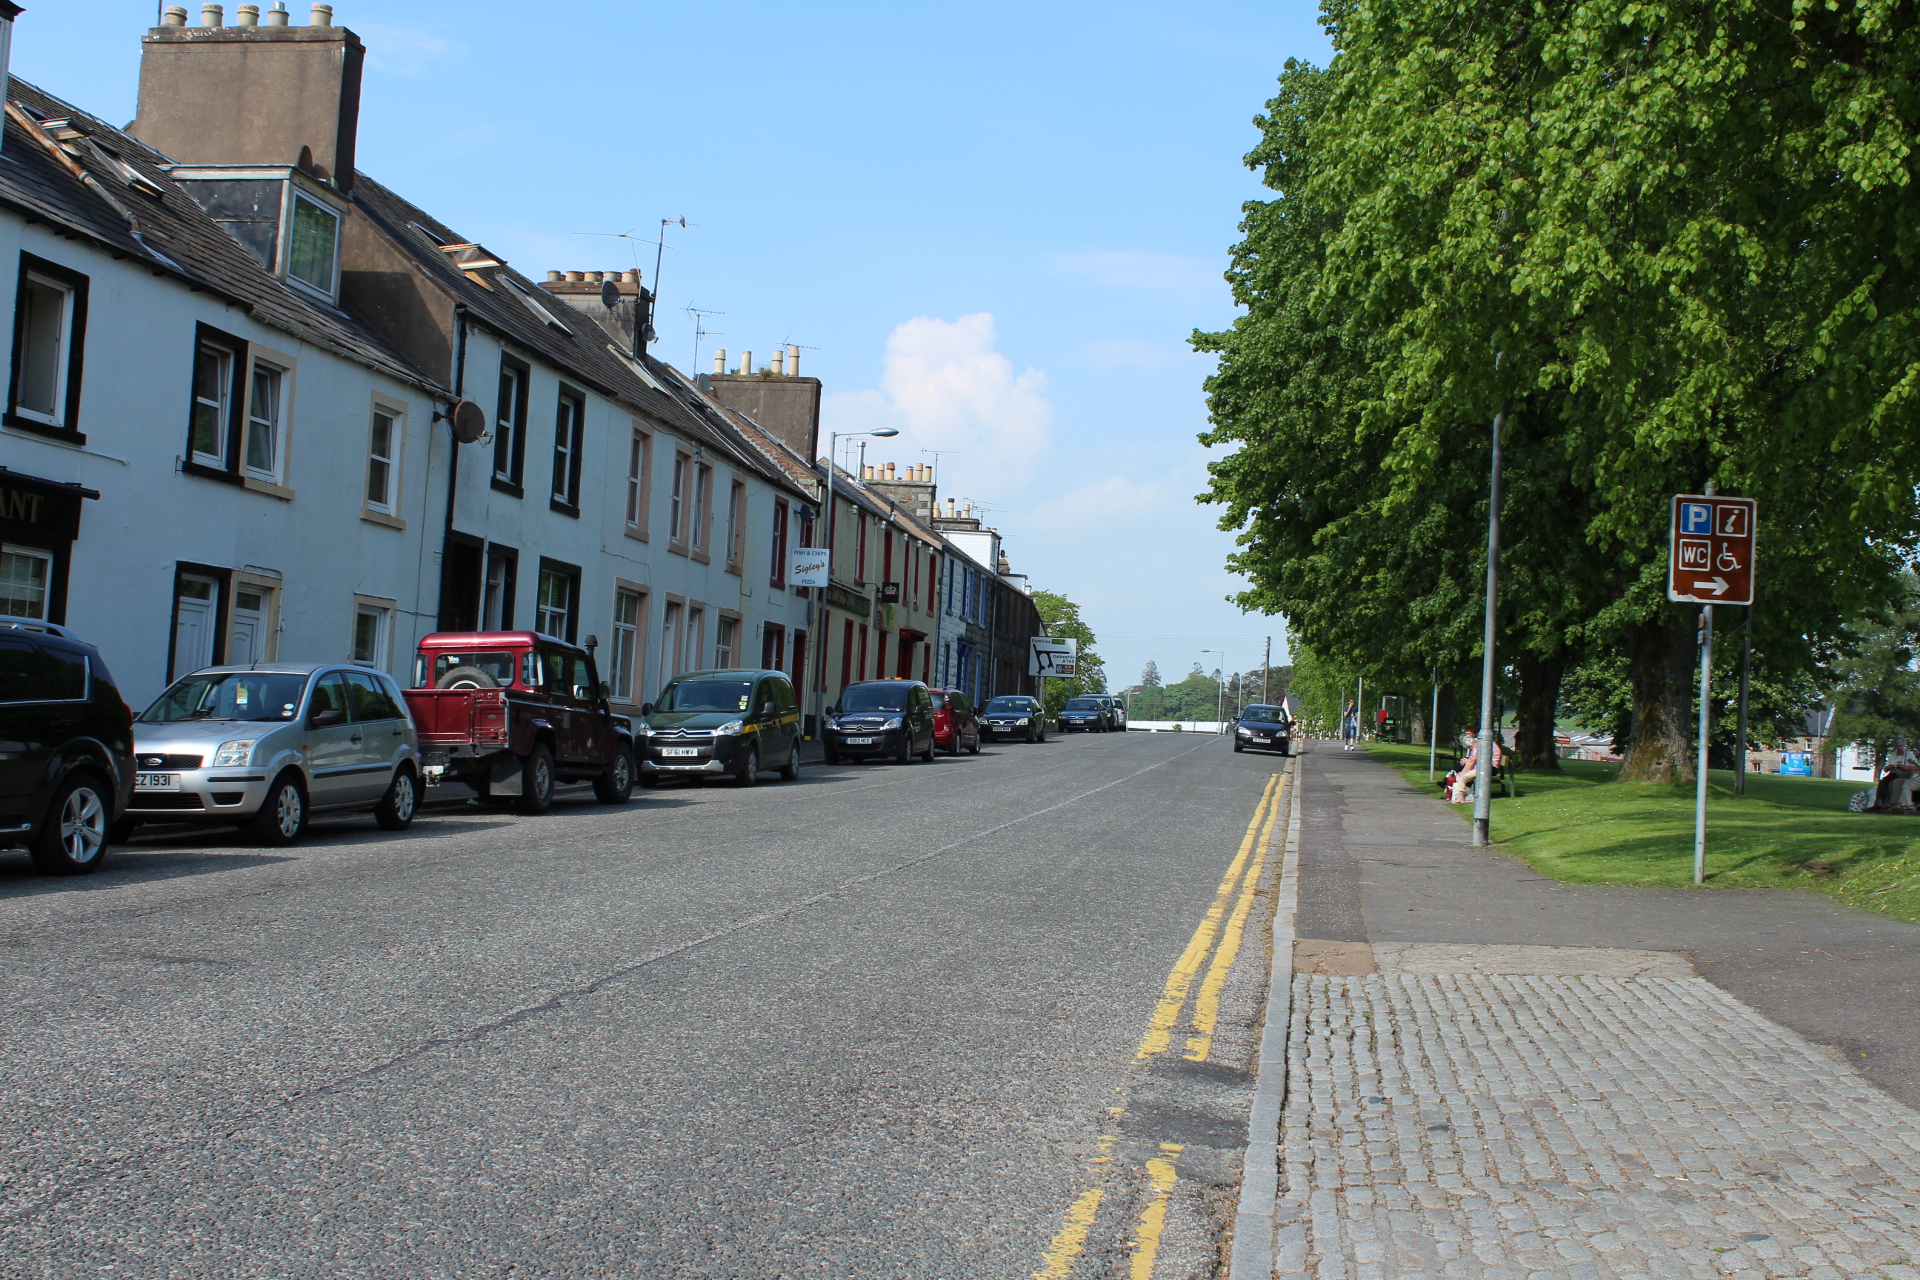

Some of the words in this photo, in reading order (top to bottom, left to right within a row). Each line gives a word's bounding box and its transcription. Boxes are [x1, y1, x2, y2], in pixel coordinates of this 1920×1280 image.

[1688, 505, 1707, 531] P
[1683, 546, 1707, 564] WC
[794, 560, 826, 575] Sigley's
[149, 775, 171, 786] 1931
